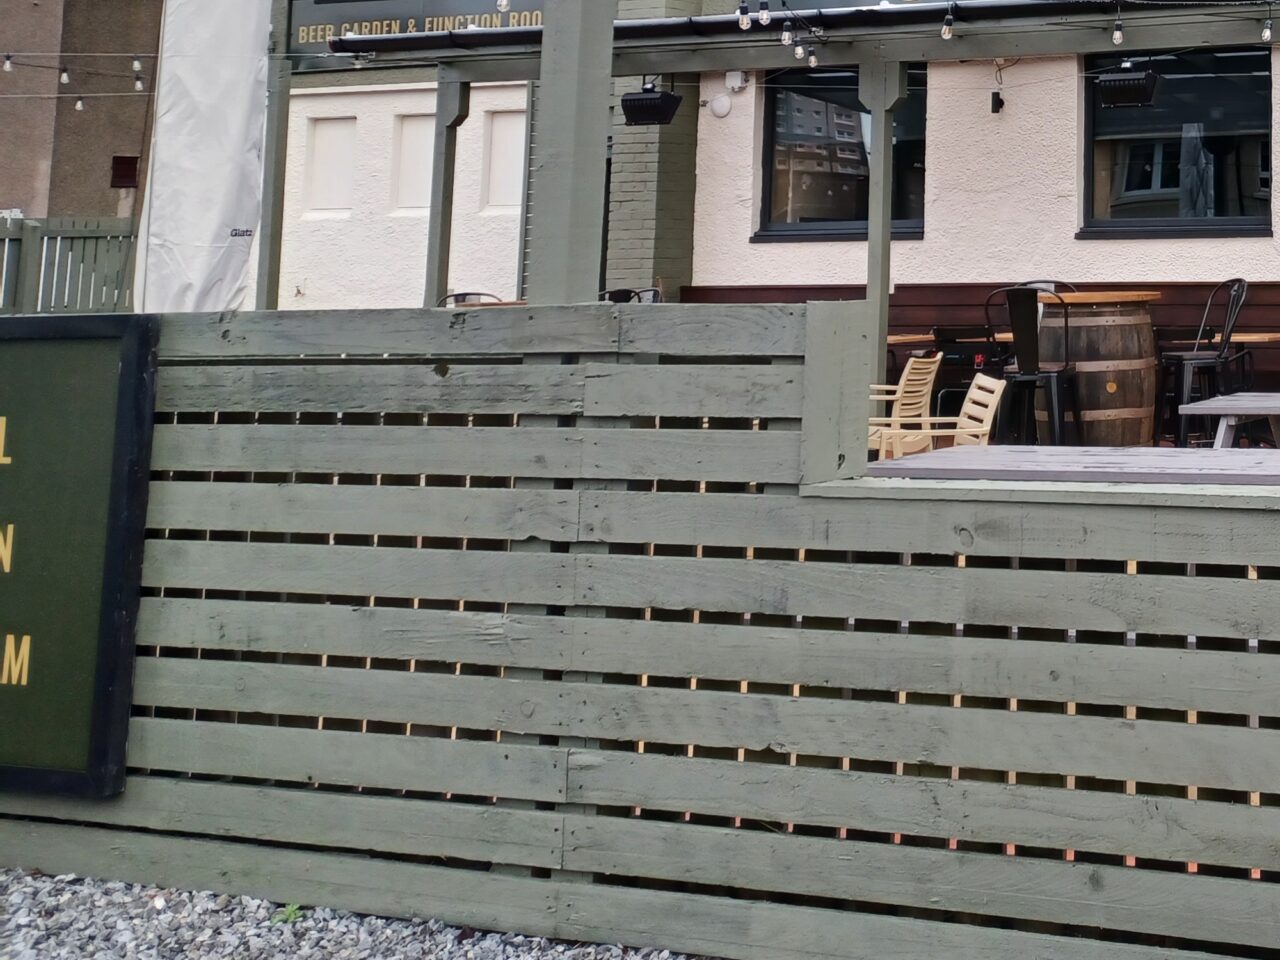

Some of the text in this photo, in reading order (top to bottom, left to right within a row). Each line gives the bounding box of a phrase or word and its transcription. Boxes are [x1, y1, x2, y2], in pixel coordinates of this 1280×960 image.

[298, 25, 335, 44] BEER
[340, 19, 401, 37] GARDEN
[407, 18, 417, 33] &
